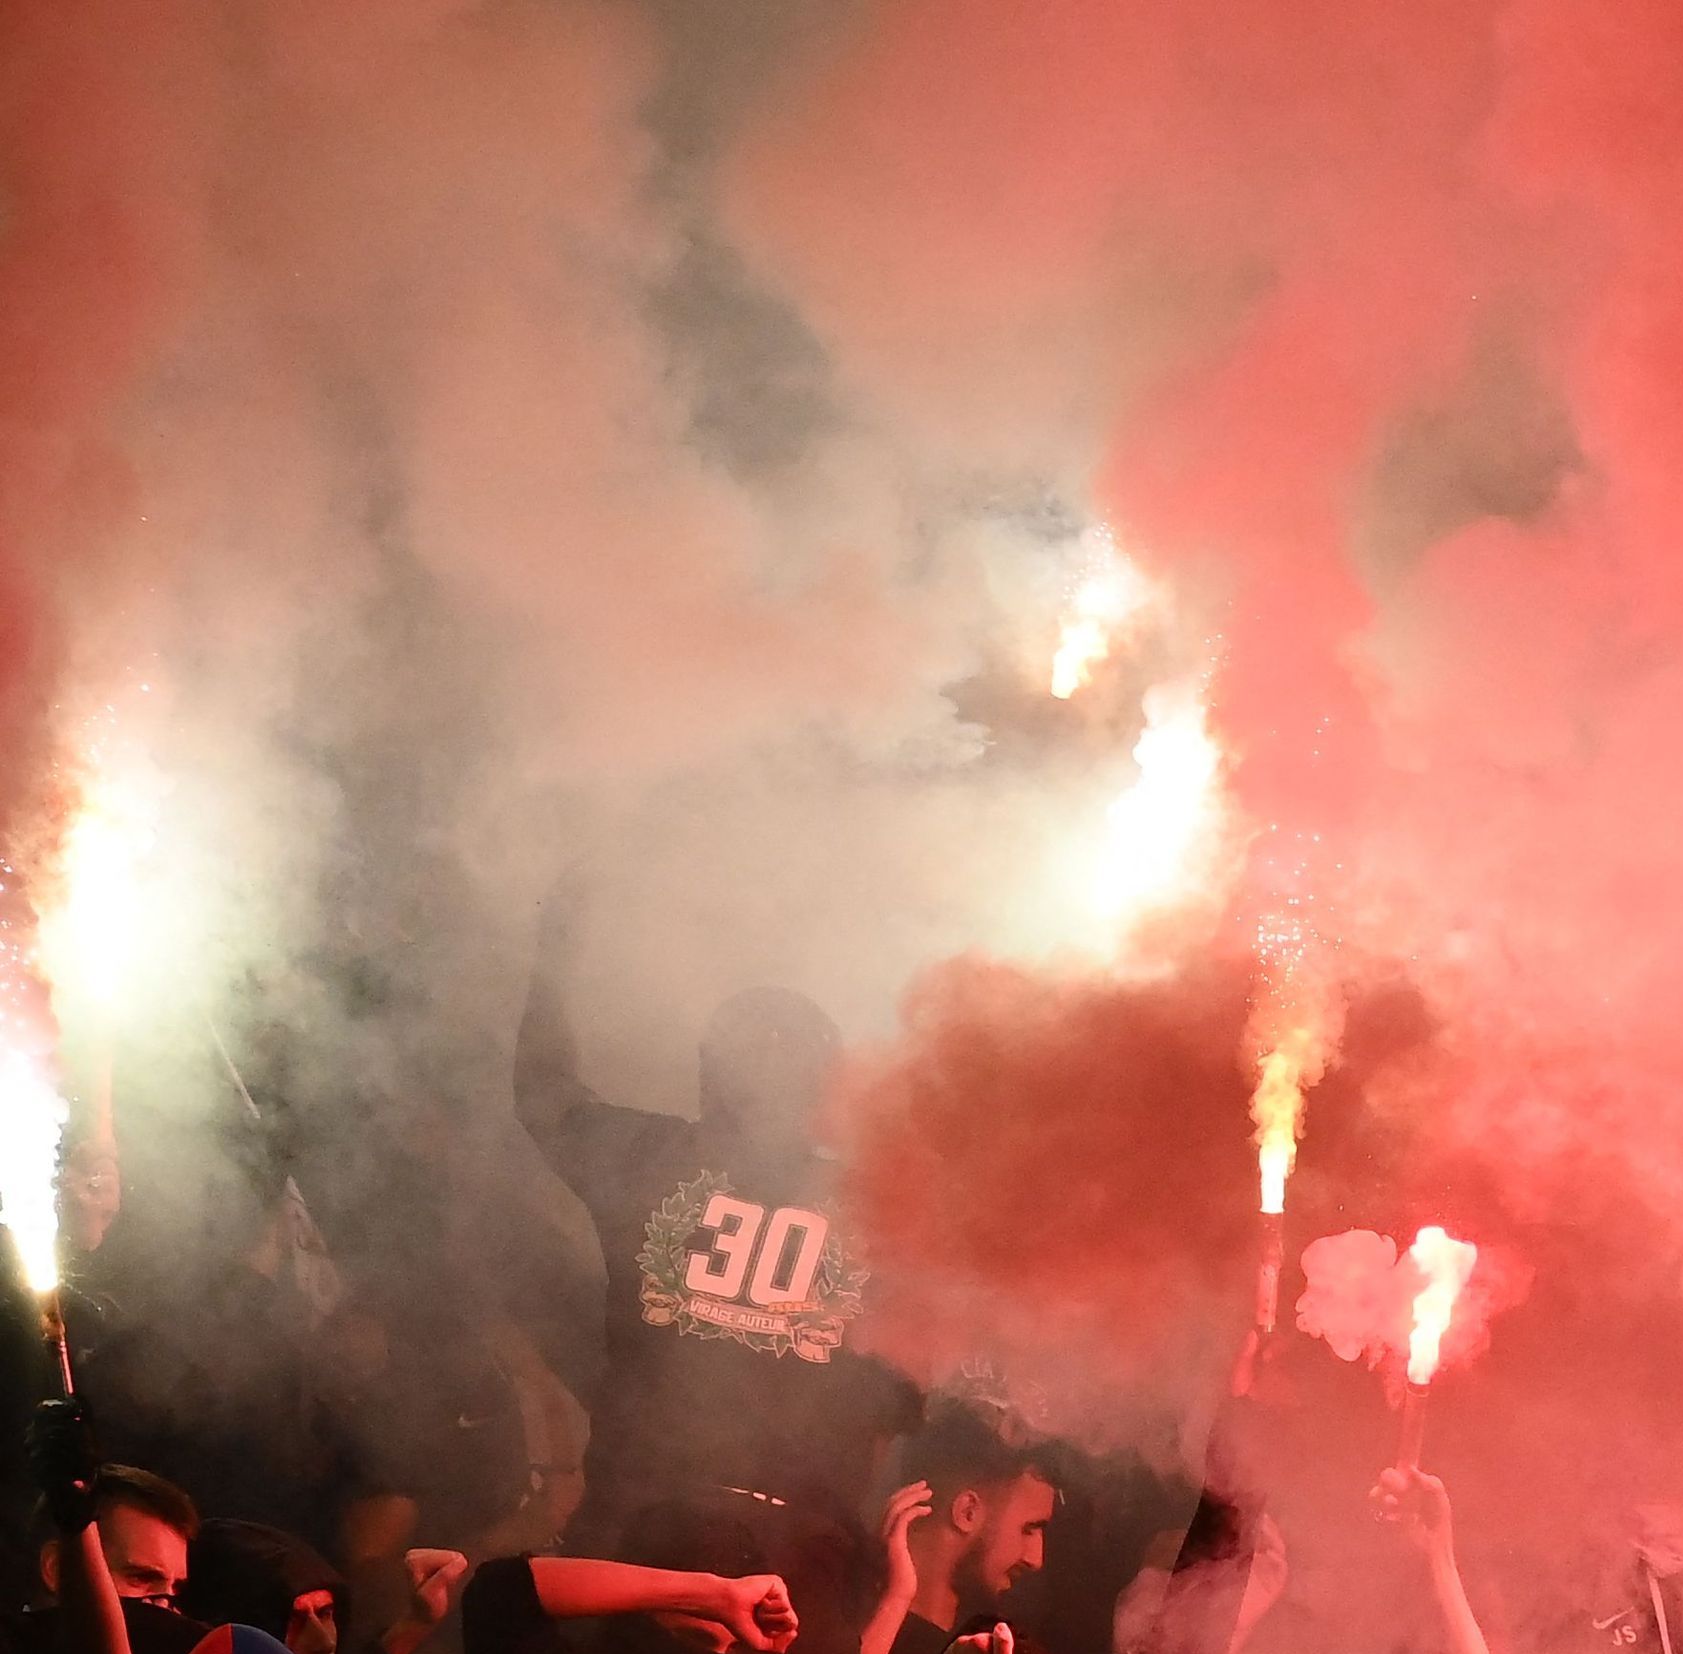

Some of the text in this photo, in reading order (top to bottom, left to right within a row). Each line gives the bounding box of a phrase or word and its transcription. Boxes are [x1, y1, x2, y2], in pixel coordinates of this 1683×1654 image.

[684, 1194, 829, 1306] 30
[689, 1299, 734, 1326] VIRAGE
[1612, 1626, 1637, 1647] JS
